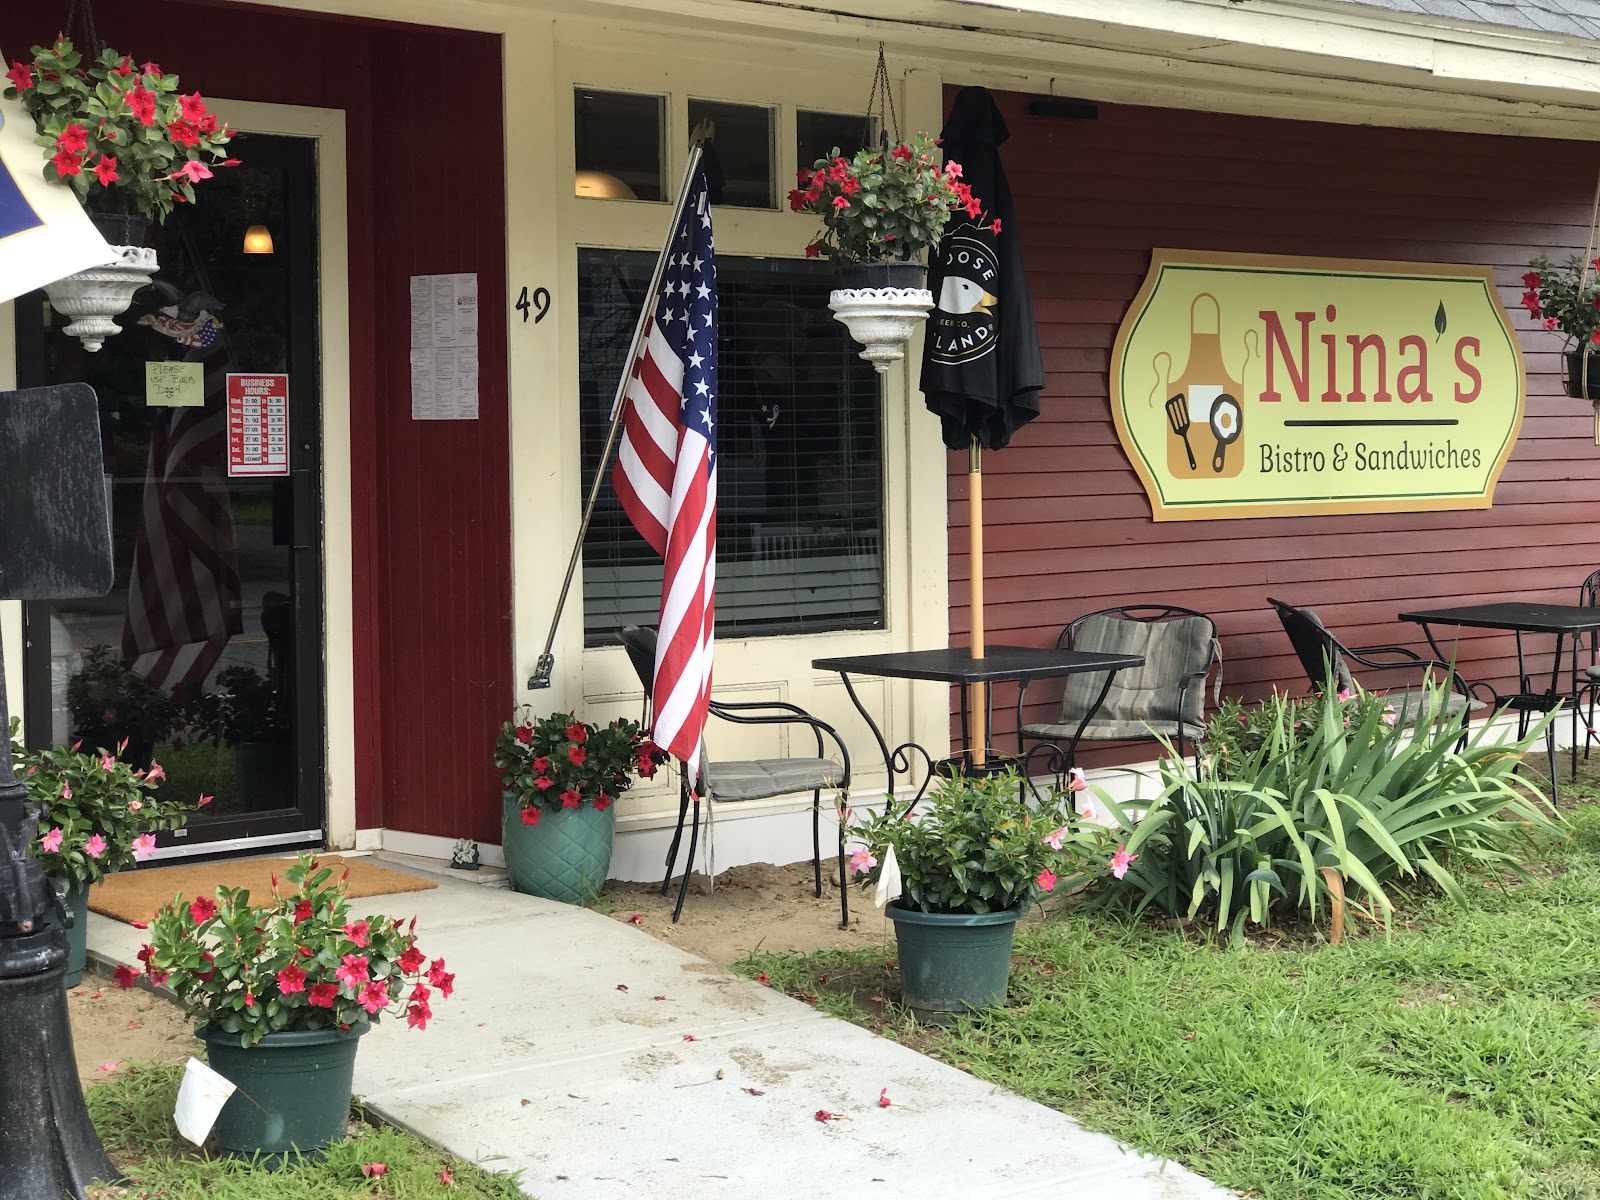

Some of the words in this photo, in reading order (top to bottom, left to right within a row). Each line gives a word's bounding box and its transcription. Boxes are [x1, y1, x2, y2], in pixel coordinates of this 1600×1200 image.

[515, 286, 551, 324] 49
[1258, 300, 1482, 403] Nina's
[149, 362, 186, 375] PLEASE
[240, 378, 275, 387] BUSINESS
[244, 387, 271, 395] HOURS:
[1259, 443, 1326, 474] Bistro
[1332, 442, 1349, 473] &
[1355, 439, 1482, 472] Sandwiches
